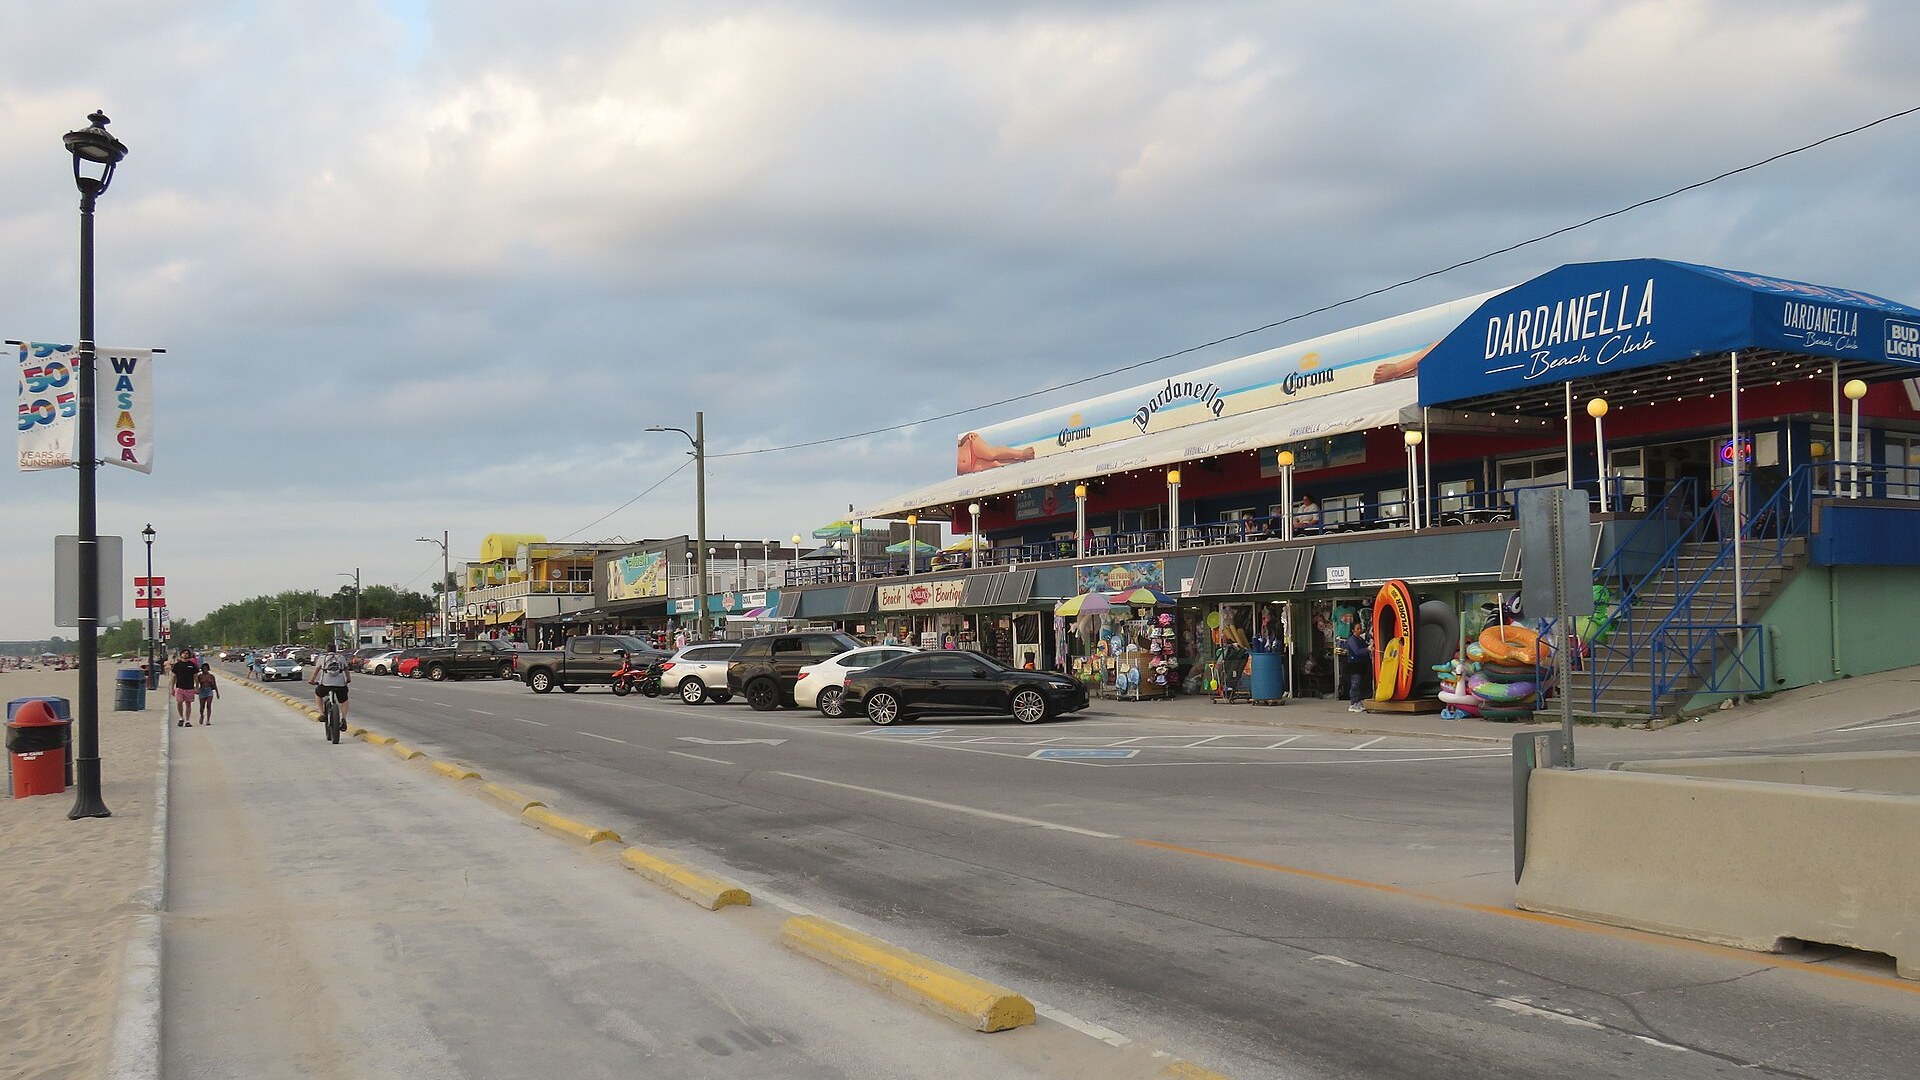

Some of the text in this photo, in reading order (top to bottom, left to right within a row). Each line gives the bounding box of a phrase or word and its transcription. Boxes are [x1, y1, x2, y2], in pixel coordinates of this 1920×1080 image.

[1485, 279, 1654, 360] DARDANELLA
[1783, 301, 1858, 337] DARDANELLA
[1891, 324, 1919, 342] BUD
[1523, 331, 1656, 380] Beach Club
[1803, 331, 1858, 351] Beach Club
[23, 361, 70, 393] 50
[1281, 367, 1334, 396] Corona
[110, 356, 139, 463] WASAGA
[1132, 378, 1226, 435] Dardanella
[1057, 426, 1091, 448] Corona
[20, 451, 54, 459] YEARS
[20, 459, 71, 467] SUNSHINE
[1332, 569, 1345, 578] COLD
[882, 588, 902, 606] Beach
[1396, 599, 1409, 637] EXPLORER
